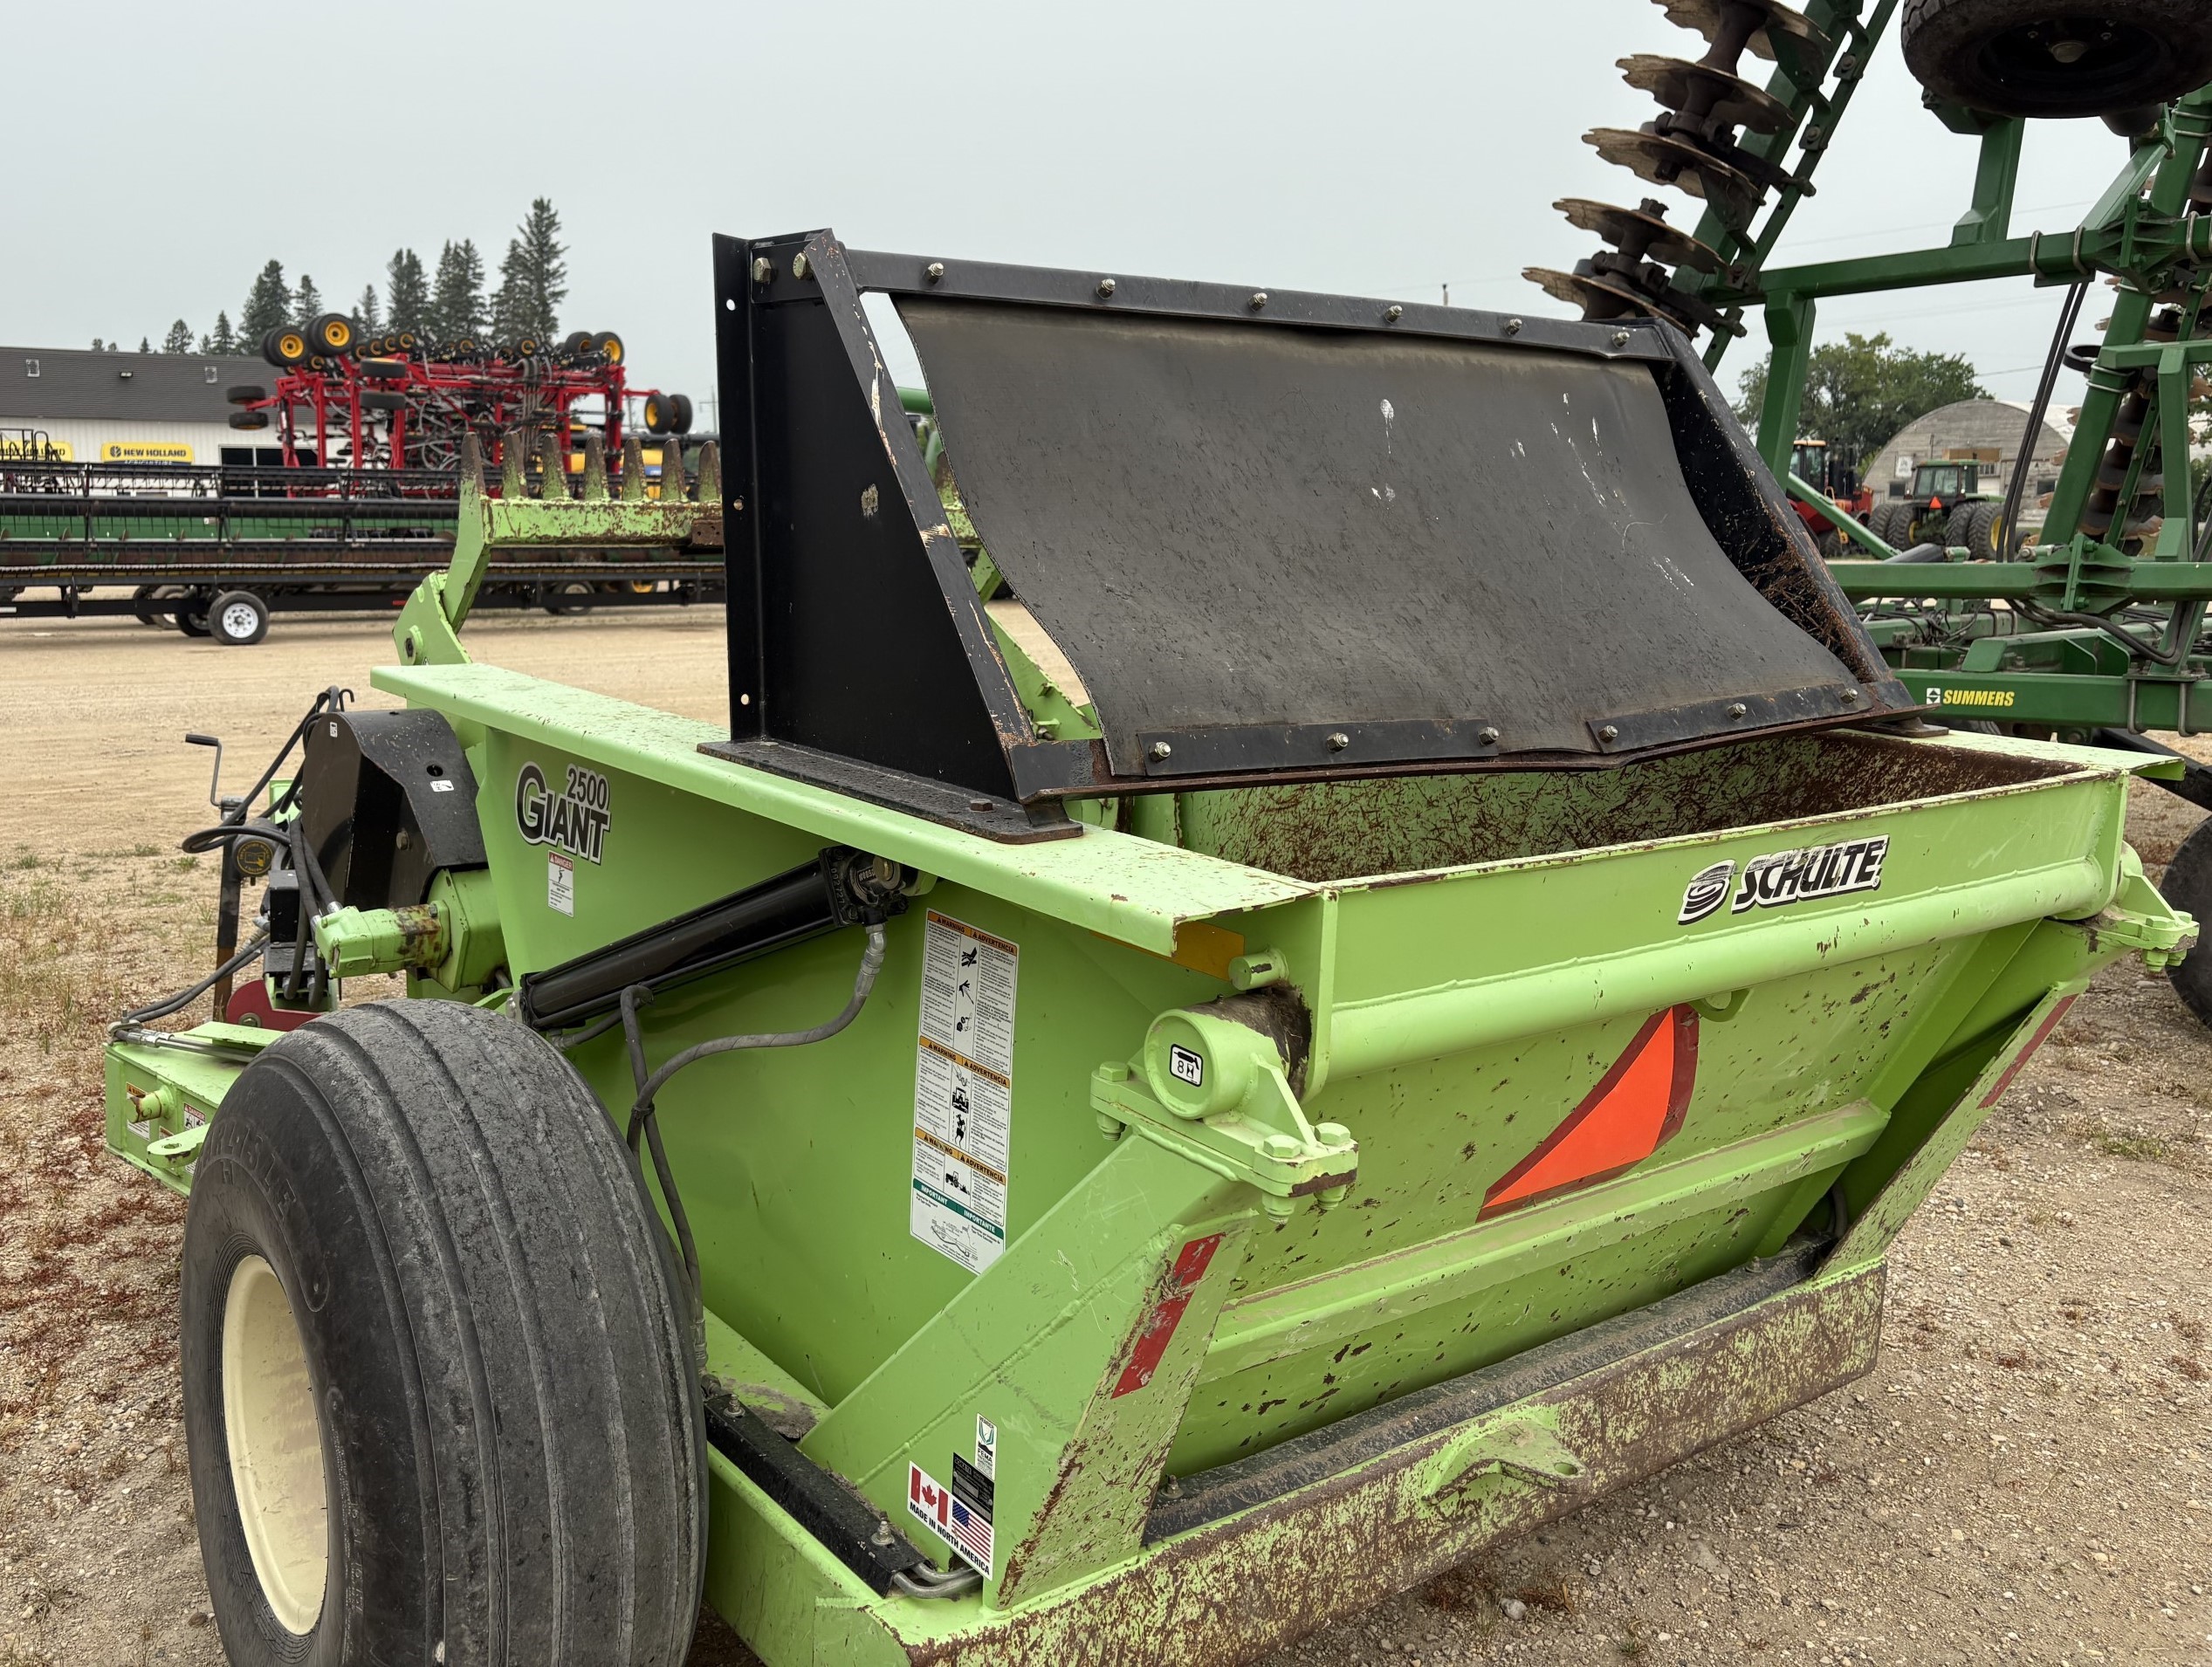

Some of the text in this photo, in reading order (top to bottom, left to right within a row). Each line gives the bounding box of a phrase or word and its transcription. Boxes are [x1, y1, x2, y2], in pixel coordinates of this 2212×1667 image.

[147, 449, 186, 457] HOLLAND
[1942, 689, 2015, 707] SUMMERS
[567, 763, 609, 810] 2500
[515, 761, 610, 864] GIANT
[554, 855, 573, 869] DANGER
[1731, 834, 1890, 914] SCHULTE
[942, 917, 1014, 954] WARNING ADVERTENCIA
[933, 1044, 1007, 1086] WARNING ADVERTENCIA
[965, 1159, 1004, 1182] ADVERTENCIA
[921, 1184, 948, 1204] IMPORTANT
[964, 1209, 996, 1233] IMPORTANTE
[978, 1448, 993, 1463] FEMA
[910, 1501, 990, 1575] MADE IN NORTH AMERICA
